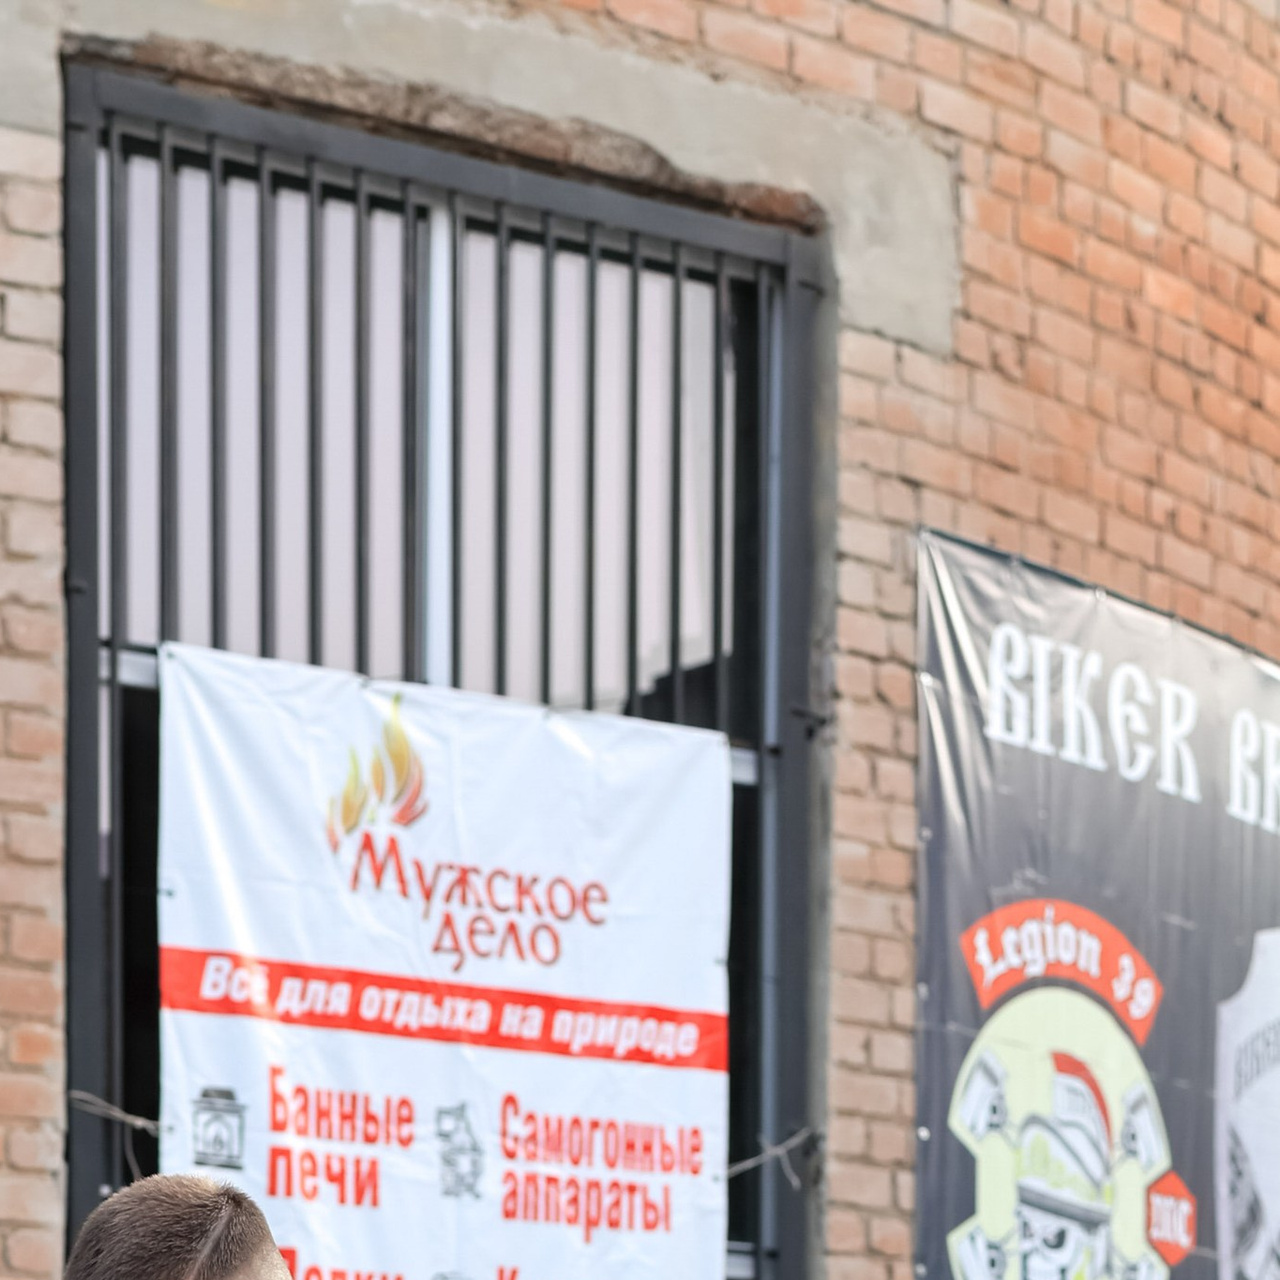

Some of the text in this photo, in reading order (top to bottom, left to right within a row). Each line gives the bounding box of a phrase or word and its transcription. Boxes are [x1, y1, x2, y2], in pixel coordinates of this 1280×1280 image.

[983, 621, 1202, 803] BIKER
[350, 832, 609, 925] Мужское
[432, 911, 561, 972] дело
[974, 904, 1157, 1020] Legion 39
[277, 976, 349, 1018] для
[359, 984, 491, 1034] отдыха
[500, 1006, 542, 1040] на
[553, 1010, 699, 1058] природе
[268, 1065, 415, 1148] Банные
[499, 1092, 704, 1175] Самогонные
[266, 1145, 380, 1208] печи
[501, 1170, 672, 1244] аппараты
